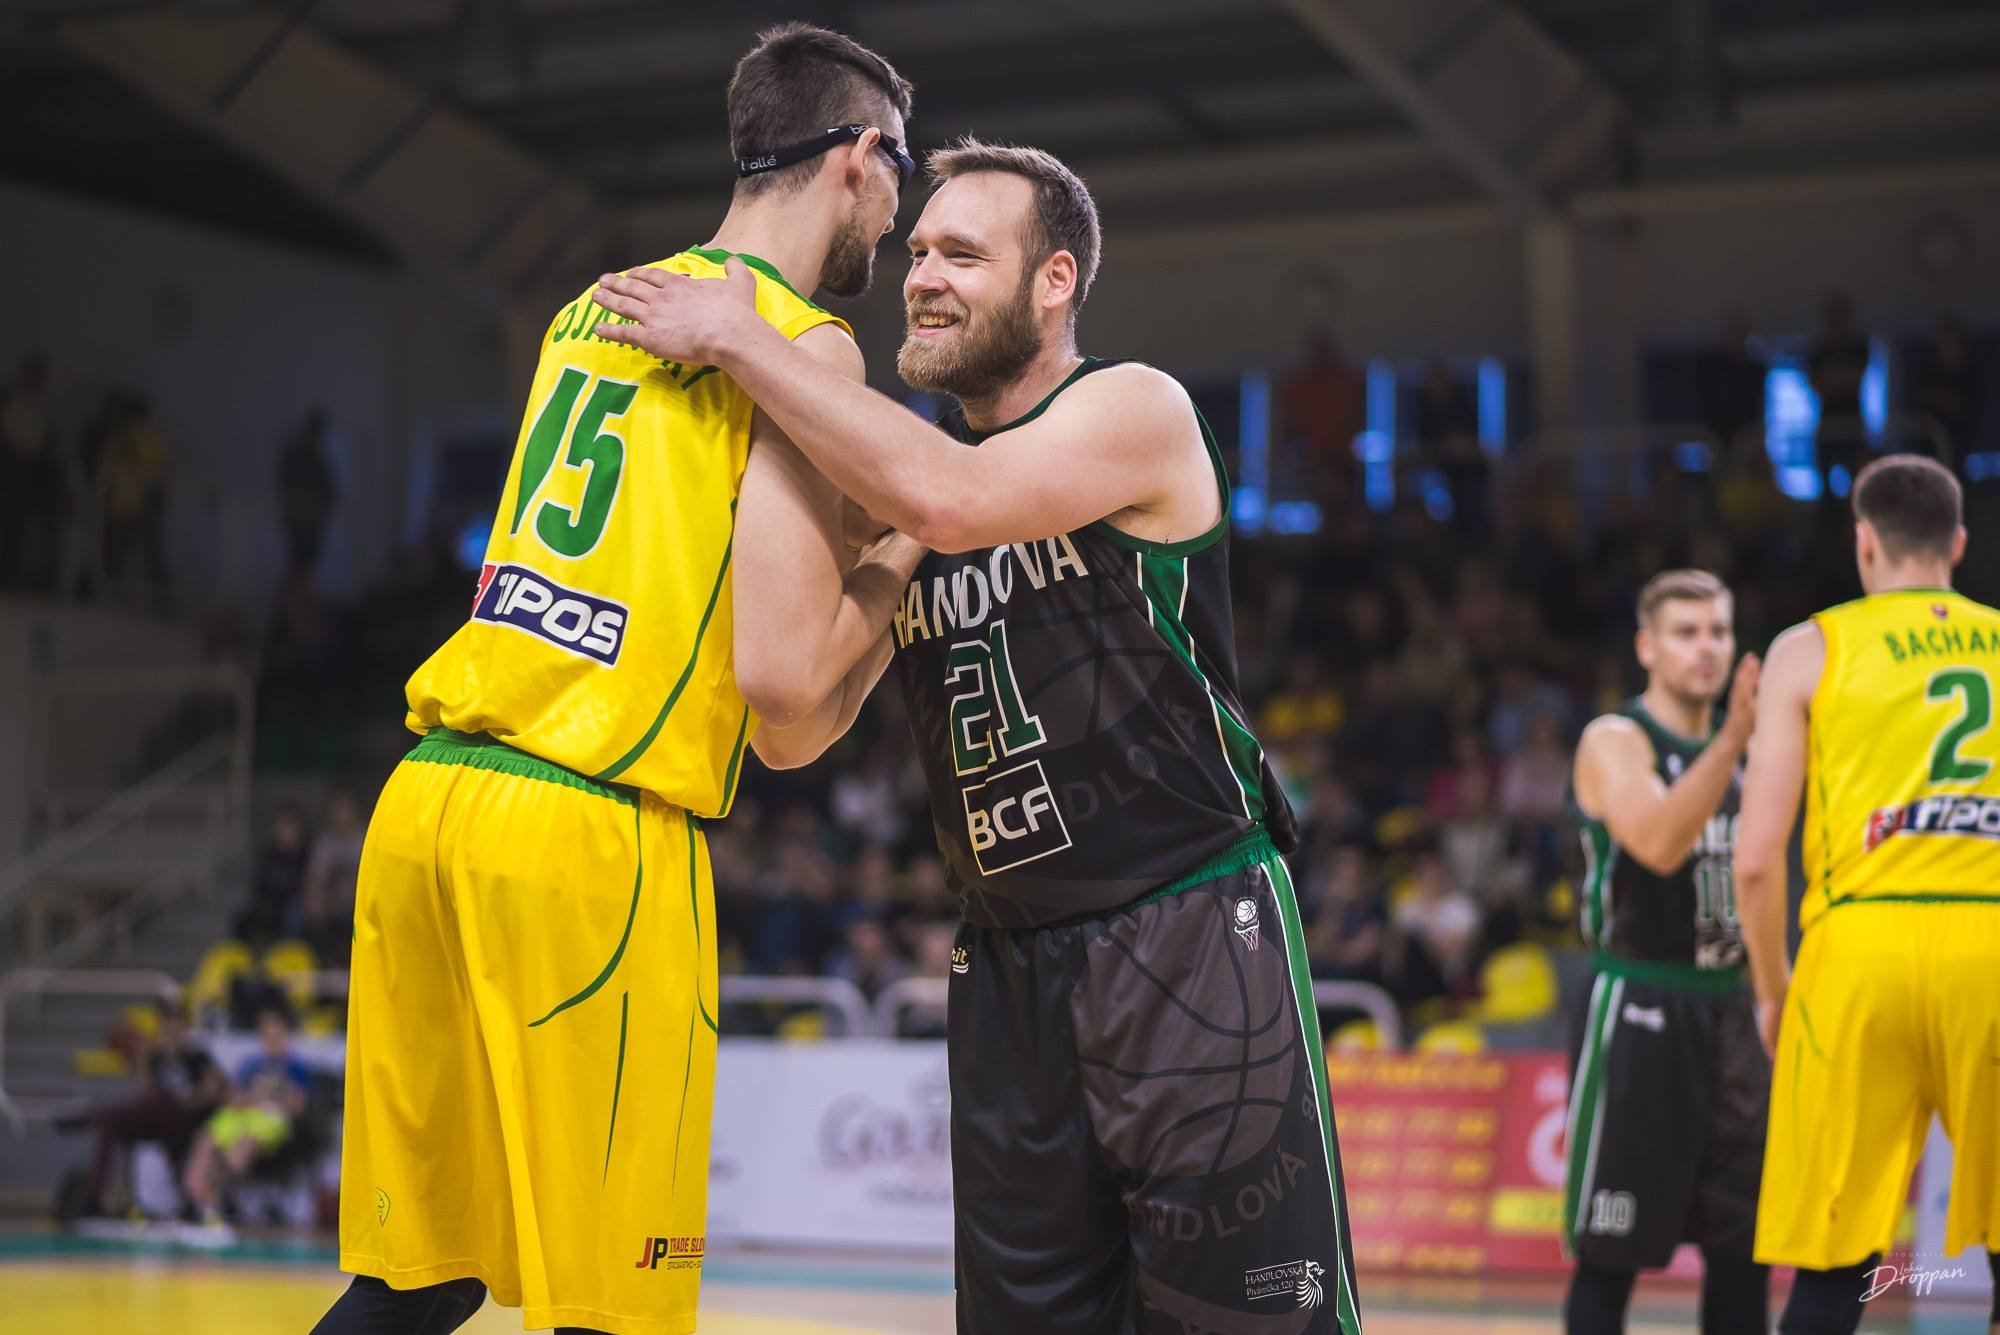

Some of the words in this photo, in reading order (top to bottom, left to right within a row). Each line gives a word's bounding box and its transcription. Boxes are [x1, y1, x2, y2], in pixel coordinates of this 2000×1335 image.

[510, 364, 640, 561] 15
[944, 619, 1047, 777] 21
[1925, 665, 1993, 787] 2
[969, 785, 1050, 852] BCF
[635, 1237, 669, 1270] JP
[1592, 1188, 1637, 1237] 10
